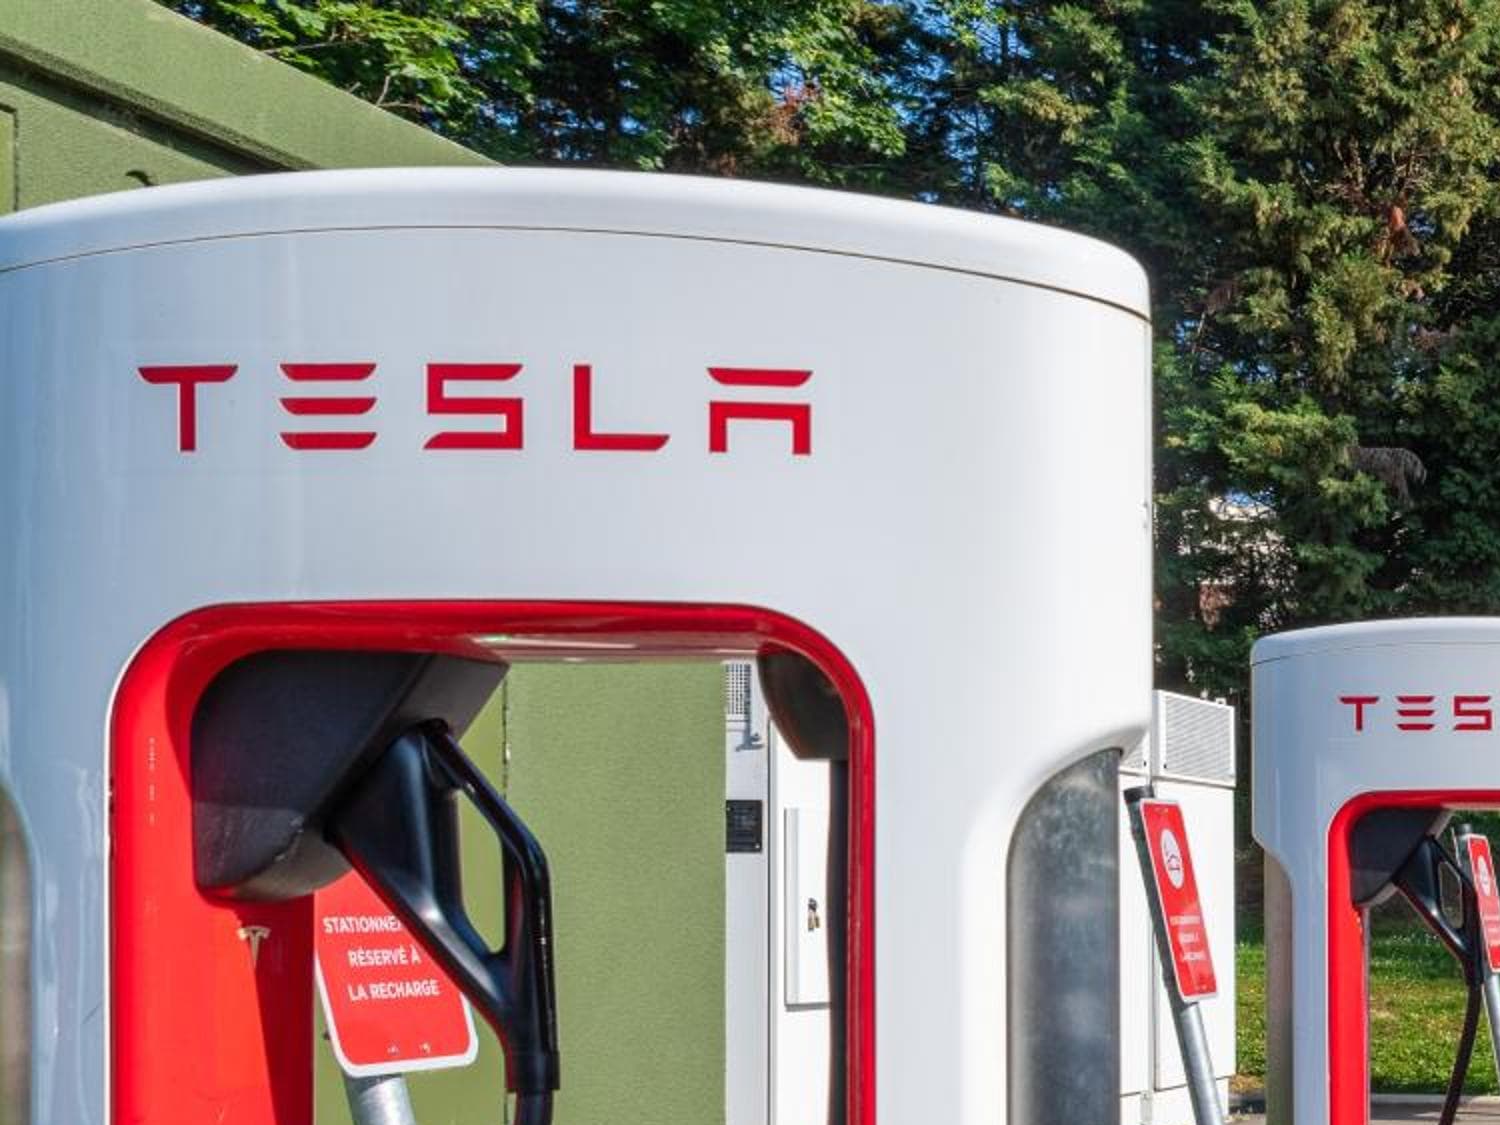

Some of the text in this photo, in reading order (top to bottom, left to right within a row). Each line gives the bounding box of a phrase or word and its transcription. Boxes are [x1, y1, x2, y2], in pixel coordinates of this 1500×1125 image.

[138, 363, 813, 455] TESLA
[347, 944, 422, 967] RÉSERVÉ À
[348, 979, 440, 1001] LA RECHARGE
